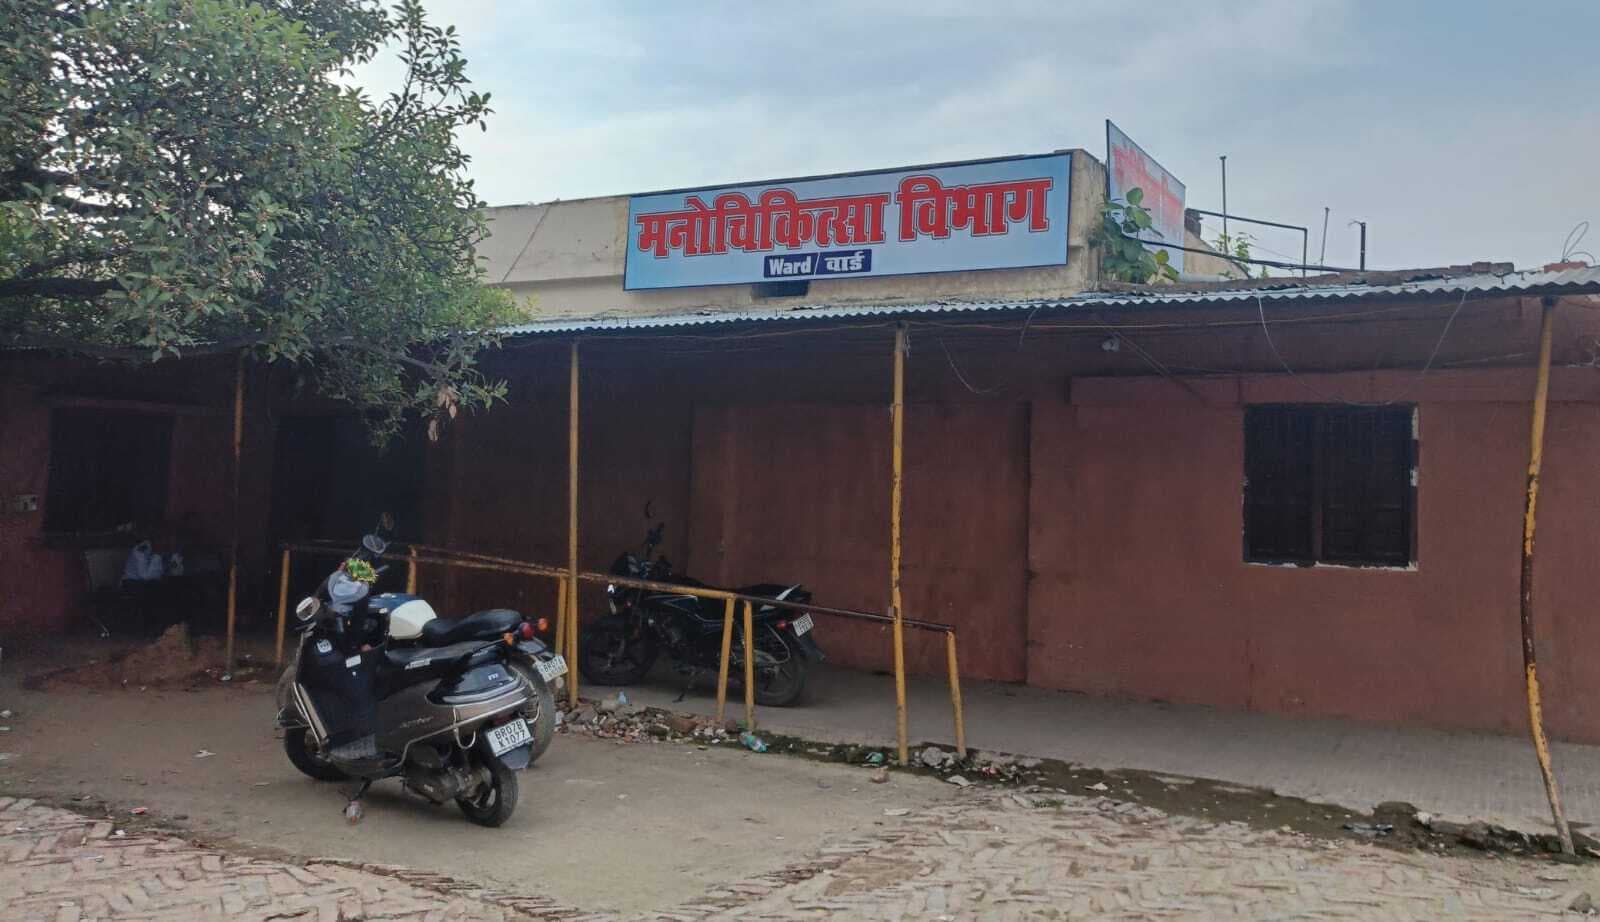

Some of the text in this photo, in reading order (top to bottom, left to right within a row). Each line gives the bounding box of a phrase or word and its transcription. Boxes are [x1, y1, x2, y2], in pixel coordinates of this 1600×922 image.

[634, 189, 890, 259] मनोचिकित्सा
[896, 175, 1053, 241] विभाग
[769, 256, 811, 275] Ward
[824, 251, 865, 272] वार्ड
